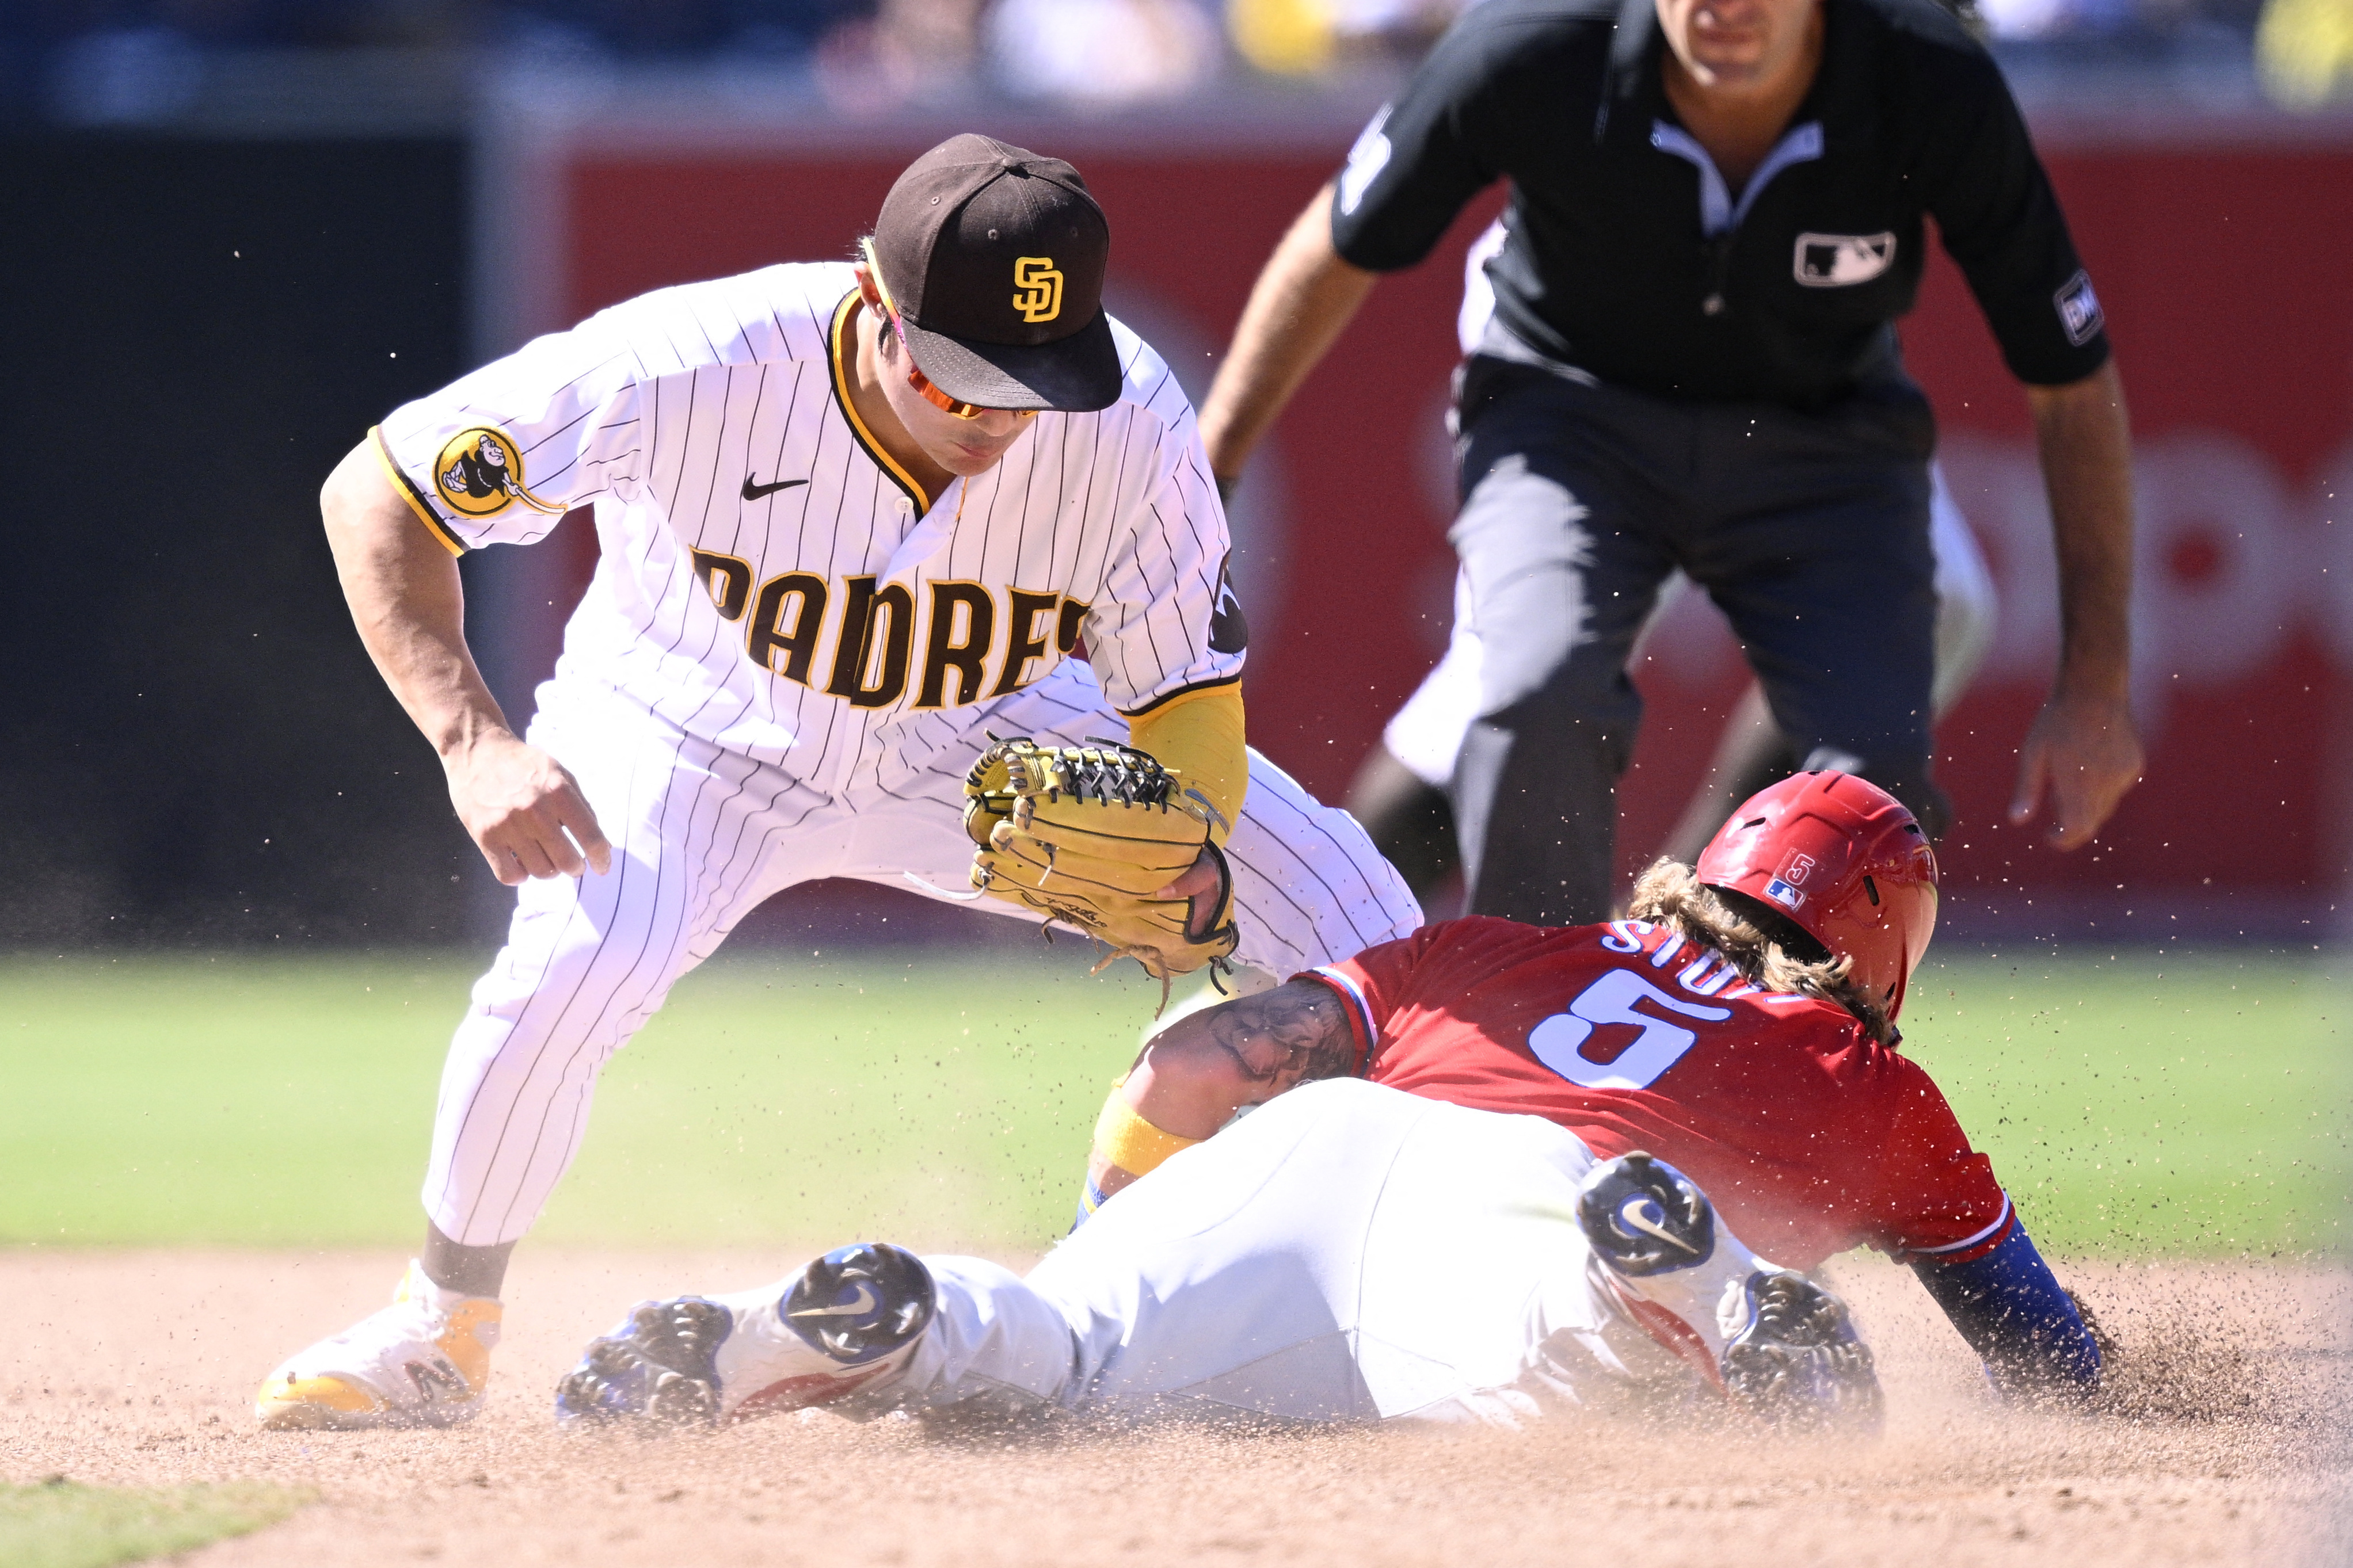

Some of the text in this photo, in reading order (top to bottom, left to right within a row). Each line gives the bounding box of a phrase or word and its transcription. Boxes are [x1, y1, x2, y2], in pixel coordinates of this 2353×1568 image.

[1012, 257, 1064, 323] SD
[1785, 853, 1815, 885] 5
[1526, 968, 1734, 1089] 5
